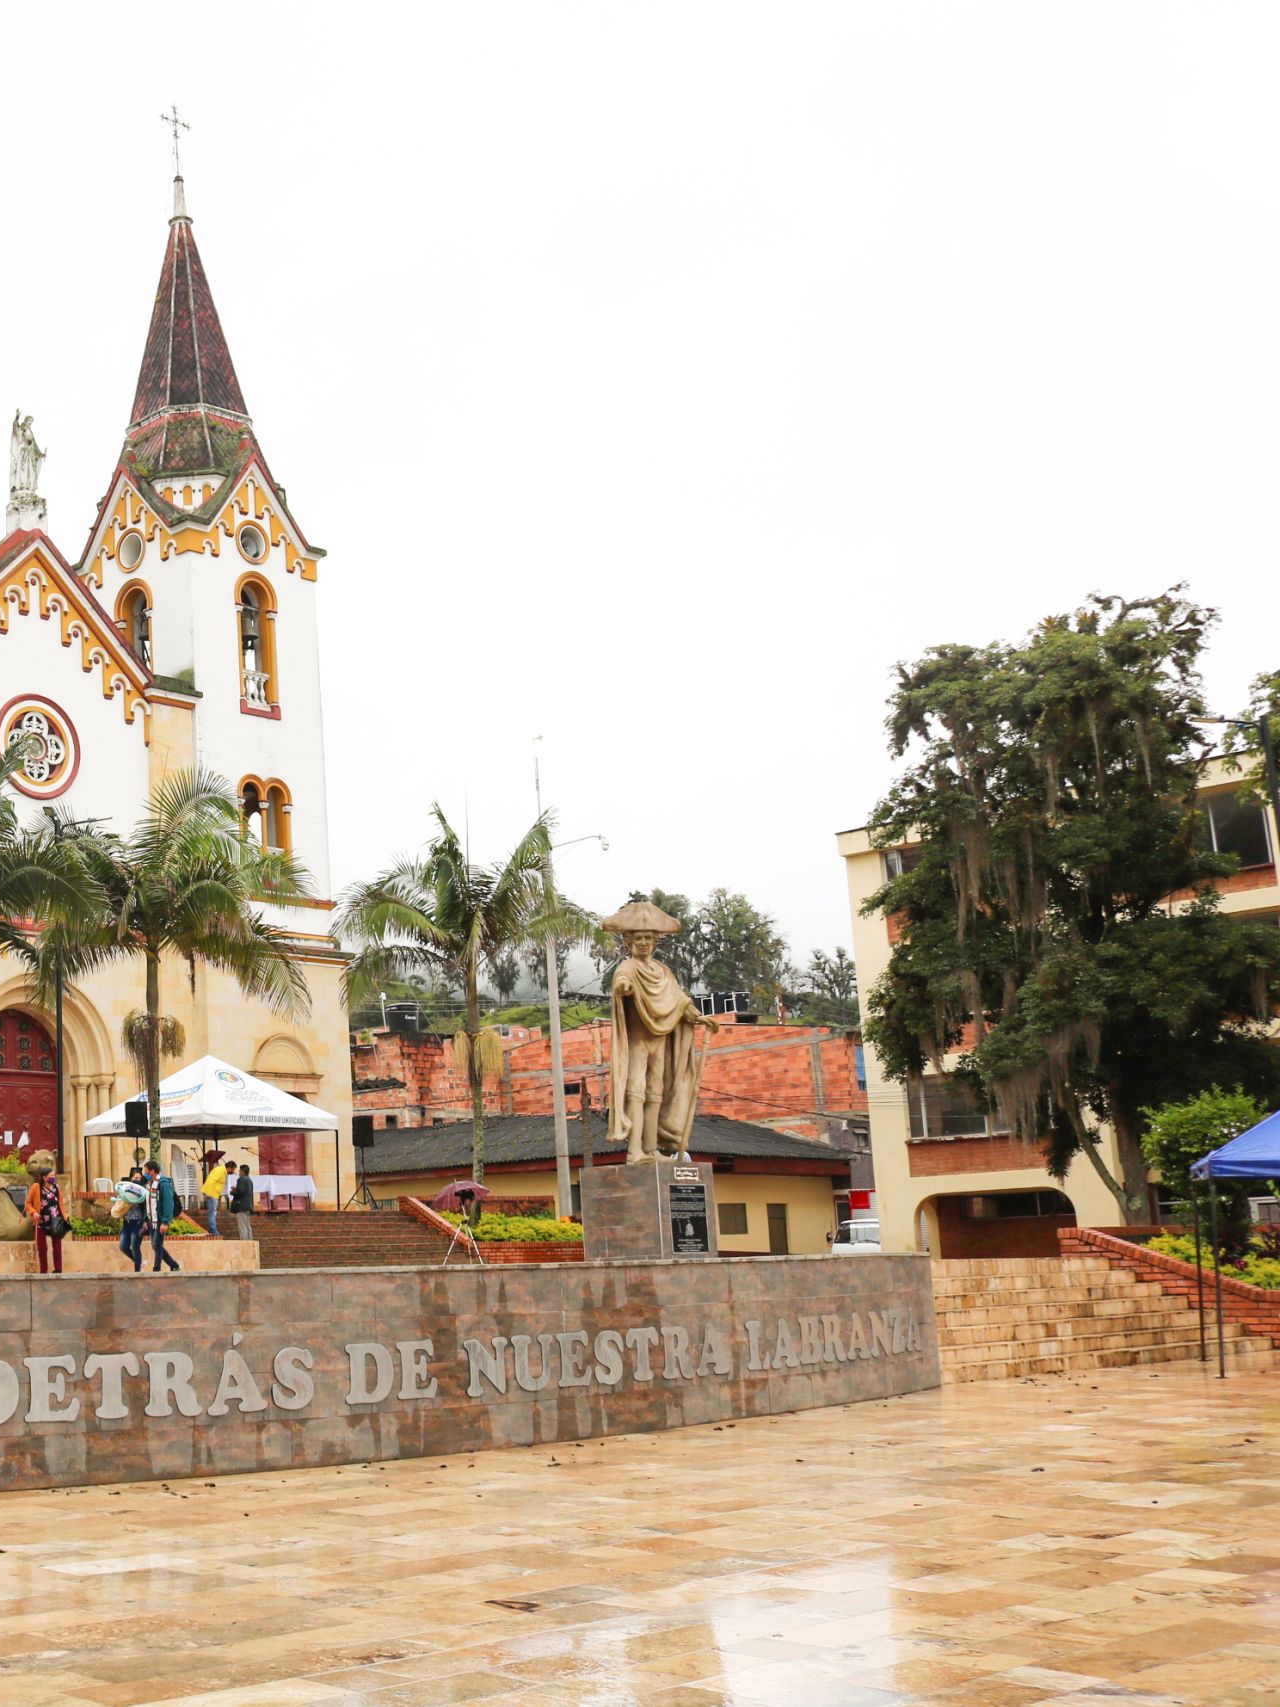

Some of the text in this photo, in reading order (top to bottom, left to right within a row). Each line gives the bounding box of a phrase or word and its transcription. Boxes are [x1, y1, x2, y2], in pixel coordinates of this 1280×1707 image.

[240, 1114, 257, 1122] PUESTO
[264, 1116, 281, 1124] MANDO
[282, 1116, 306, 1125] UNIFICADO
[112, 1122, 126, 1130] PUEST
[345, 1337, 438, 1406] DE
[463, 1321, 730, 1398] NUESTRA
[743, 1306, 923, 1373] LABRANZA
